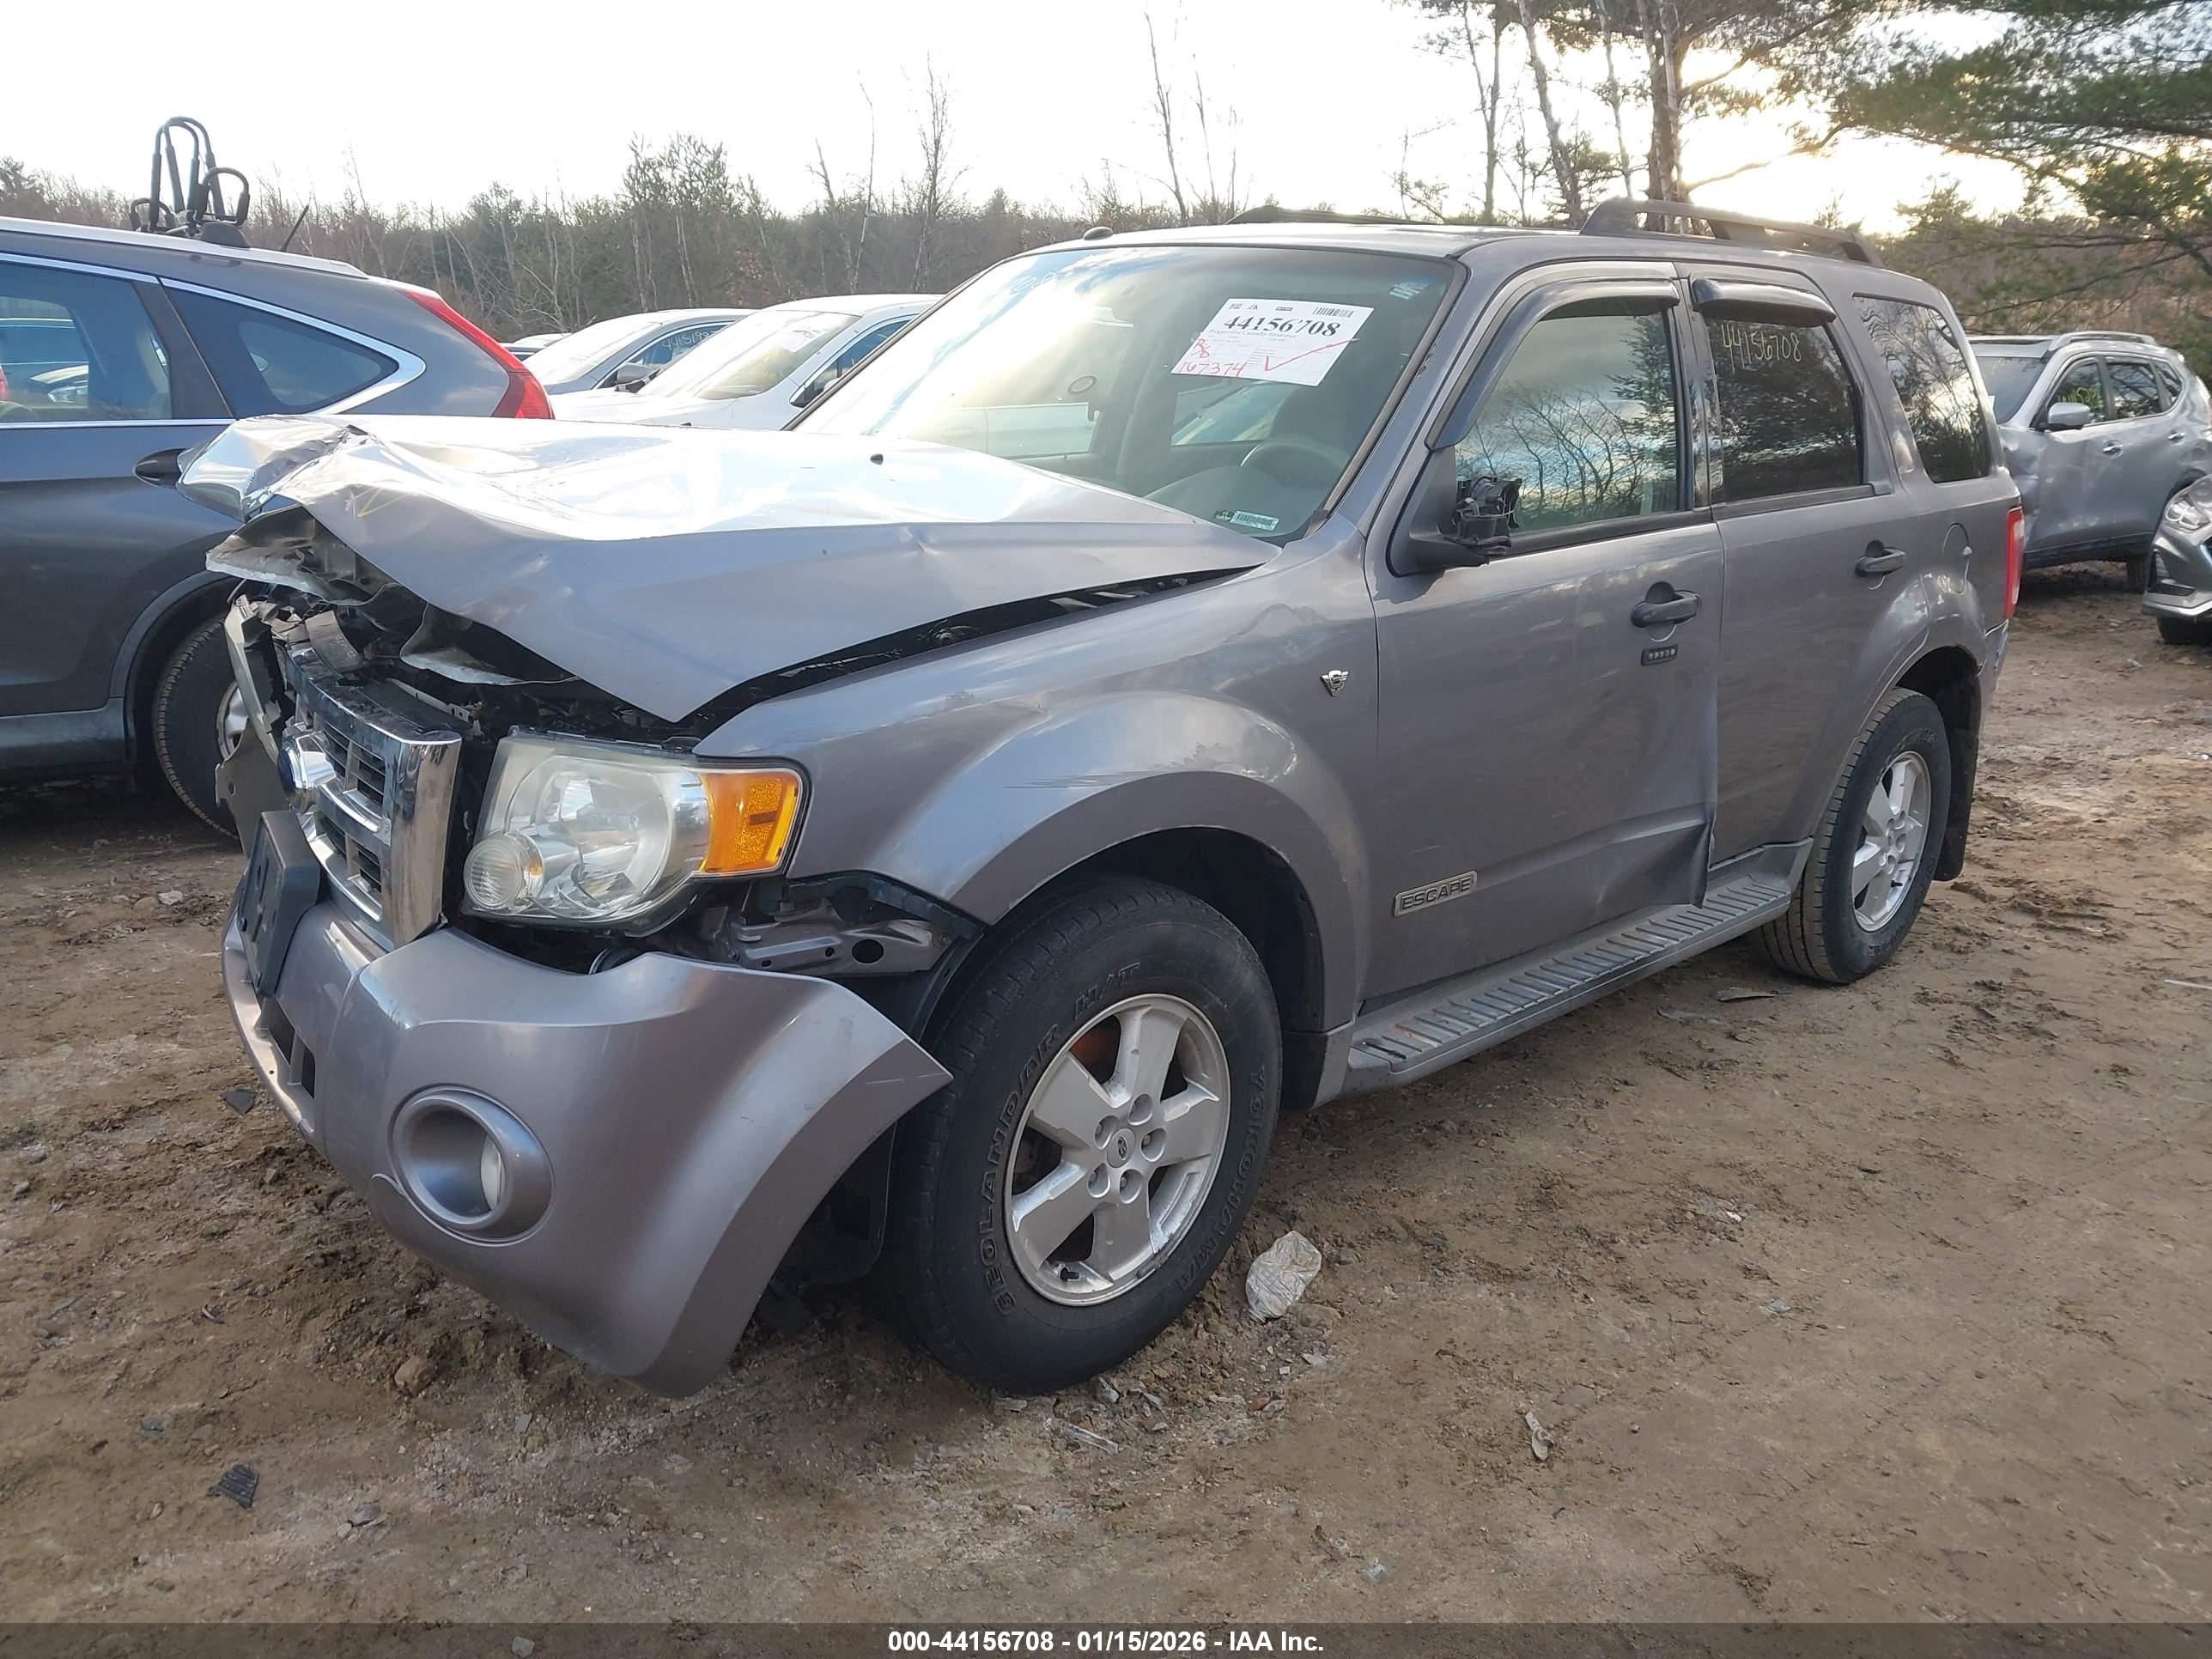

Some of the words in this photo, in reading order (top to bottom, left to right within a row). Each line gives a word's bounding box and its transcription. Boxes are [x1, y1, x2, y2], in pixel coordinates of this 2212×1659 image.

[1224, 315, 1341, 337] 44156708
[1721, 323, 1802, 374] 44156708
[1401, 876, 1472, 910] ESCAPE
[978, 1024, 1060, 1316] GEOLANDAR
[1173, 1066, 1266, 1290] YOKOHAMA
